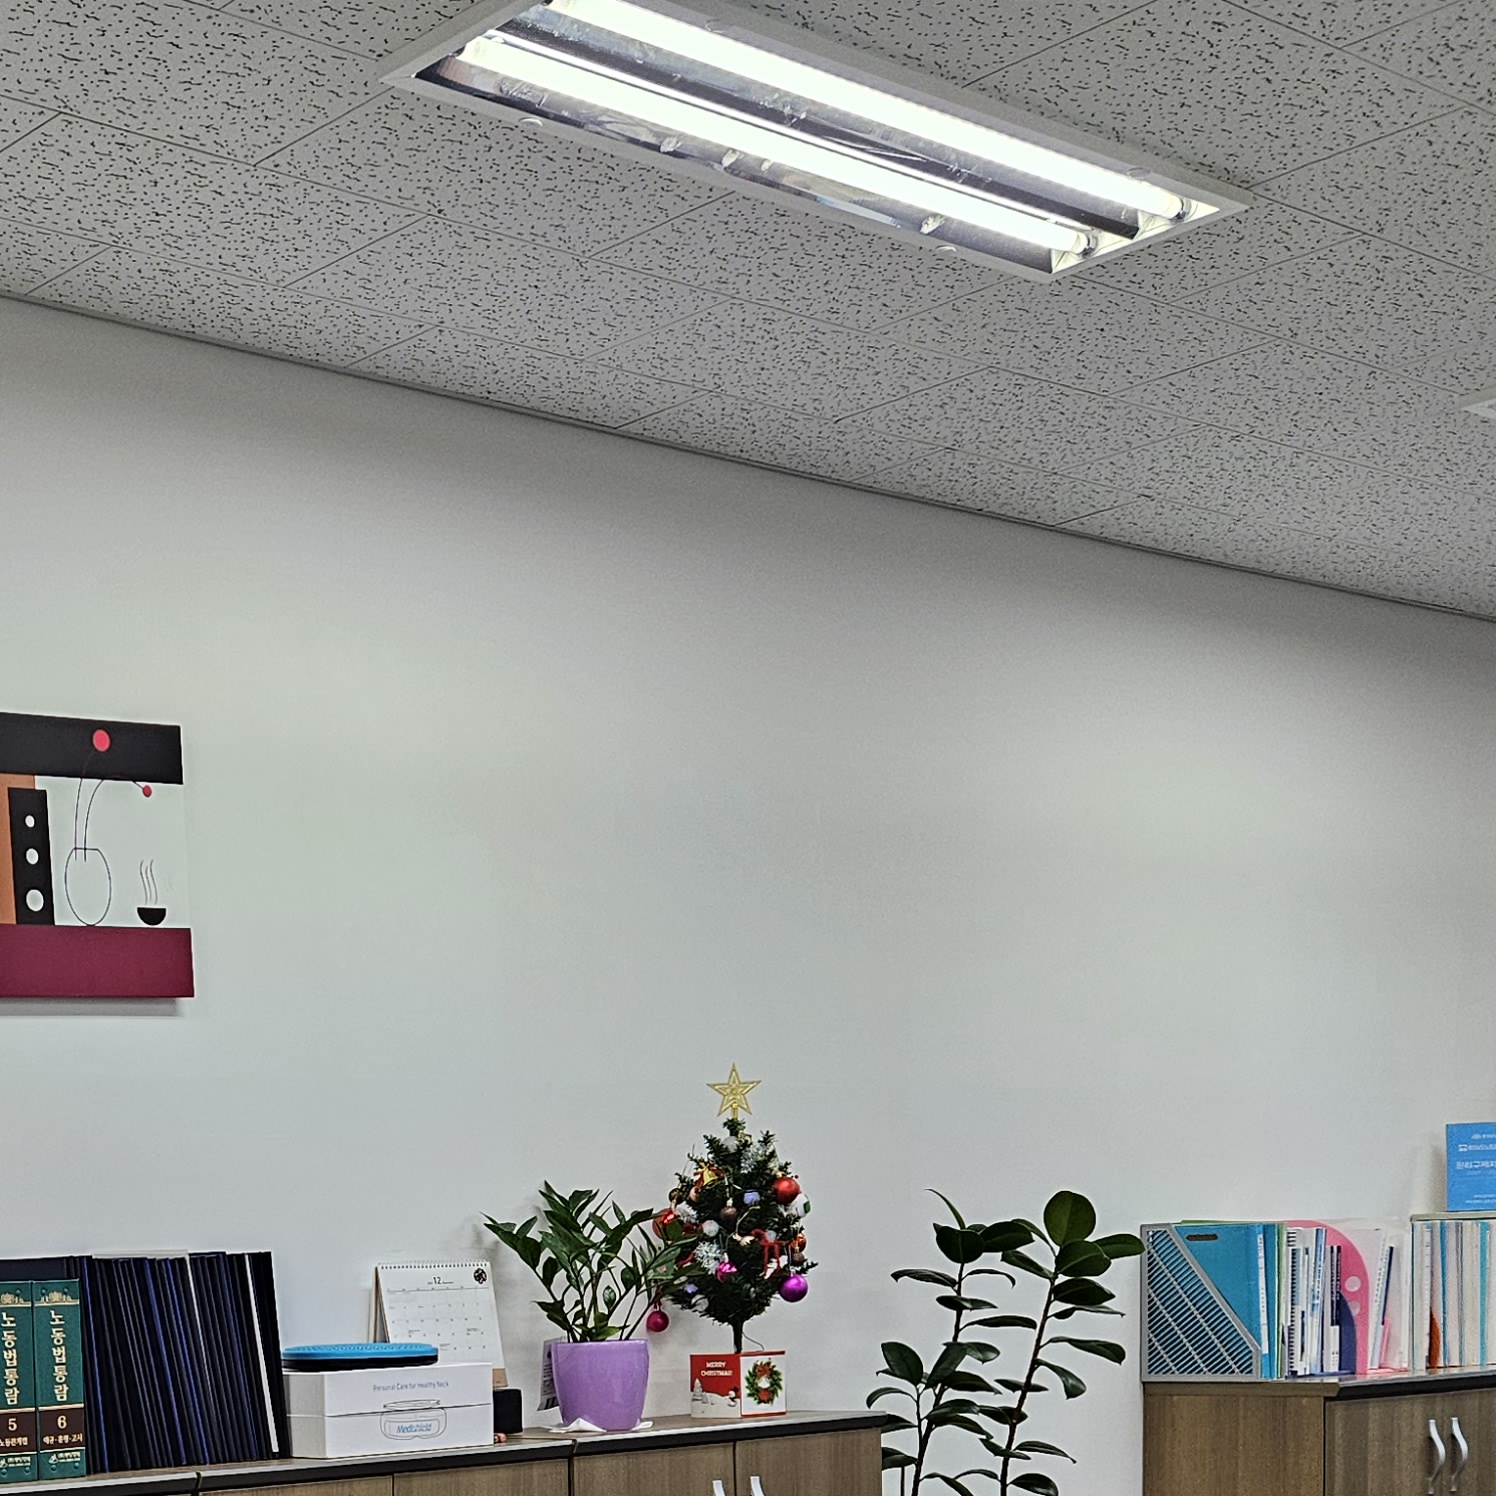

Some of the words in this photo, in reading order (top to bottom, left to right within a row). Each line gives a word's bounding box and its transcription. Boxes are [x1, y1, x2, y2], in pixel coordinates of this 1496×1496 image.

[1, 1312, 20, 1405] 노동법통람
[50, 1310, 69, 1402] 노동법통람
[8, 1418, 18, 1431] 5
[57, 1415, 67, 1429] 6
